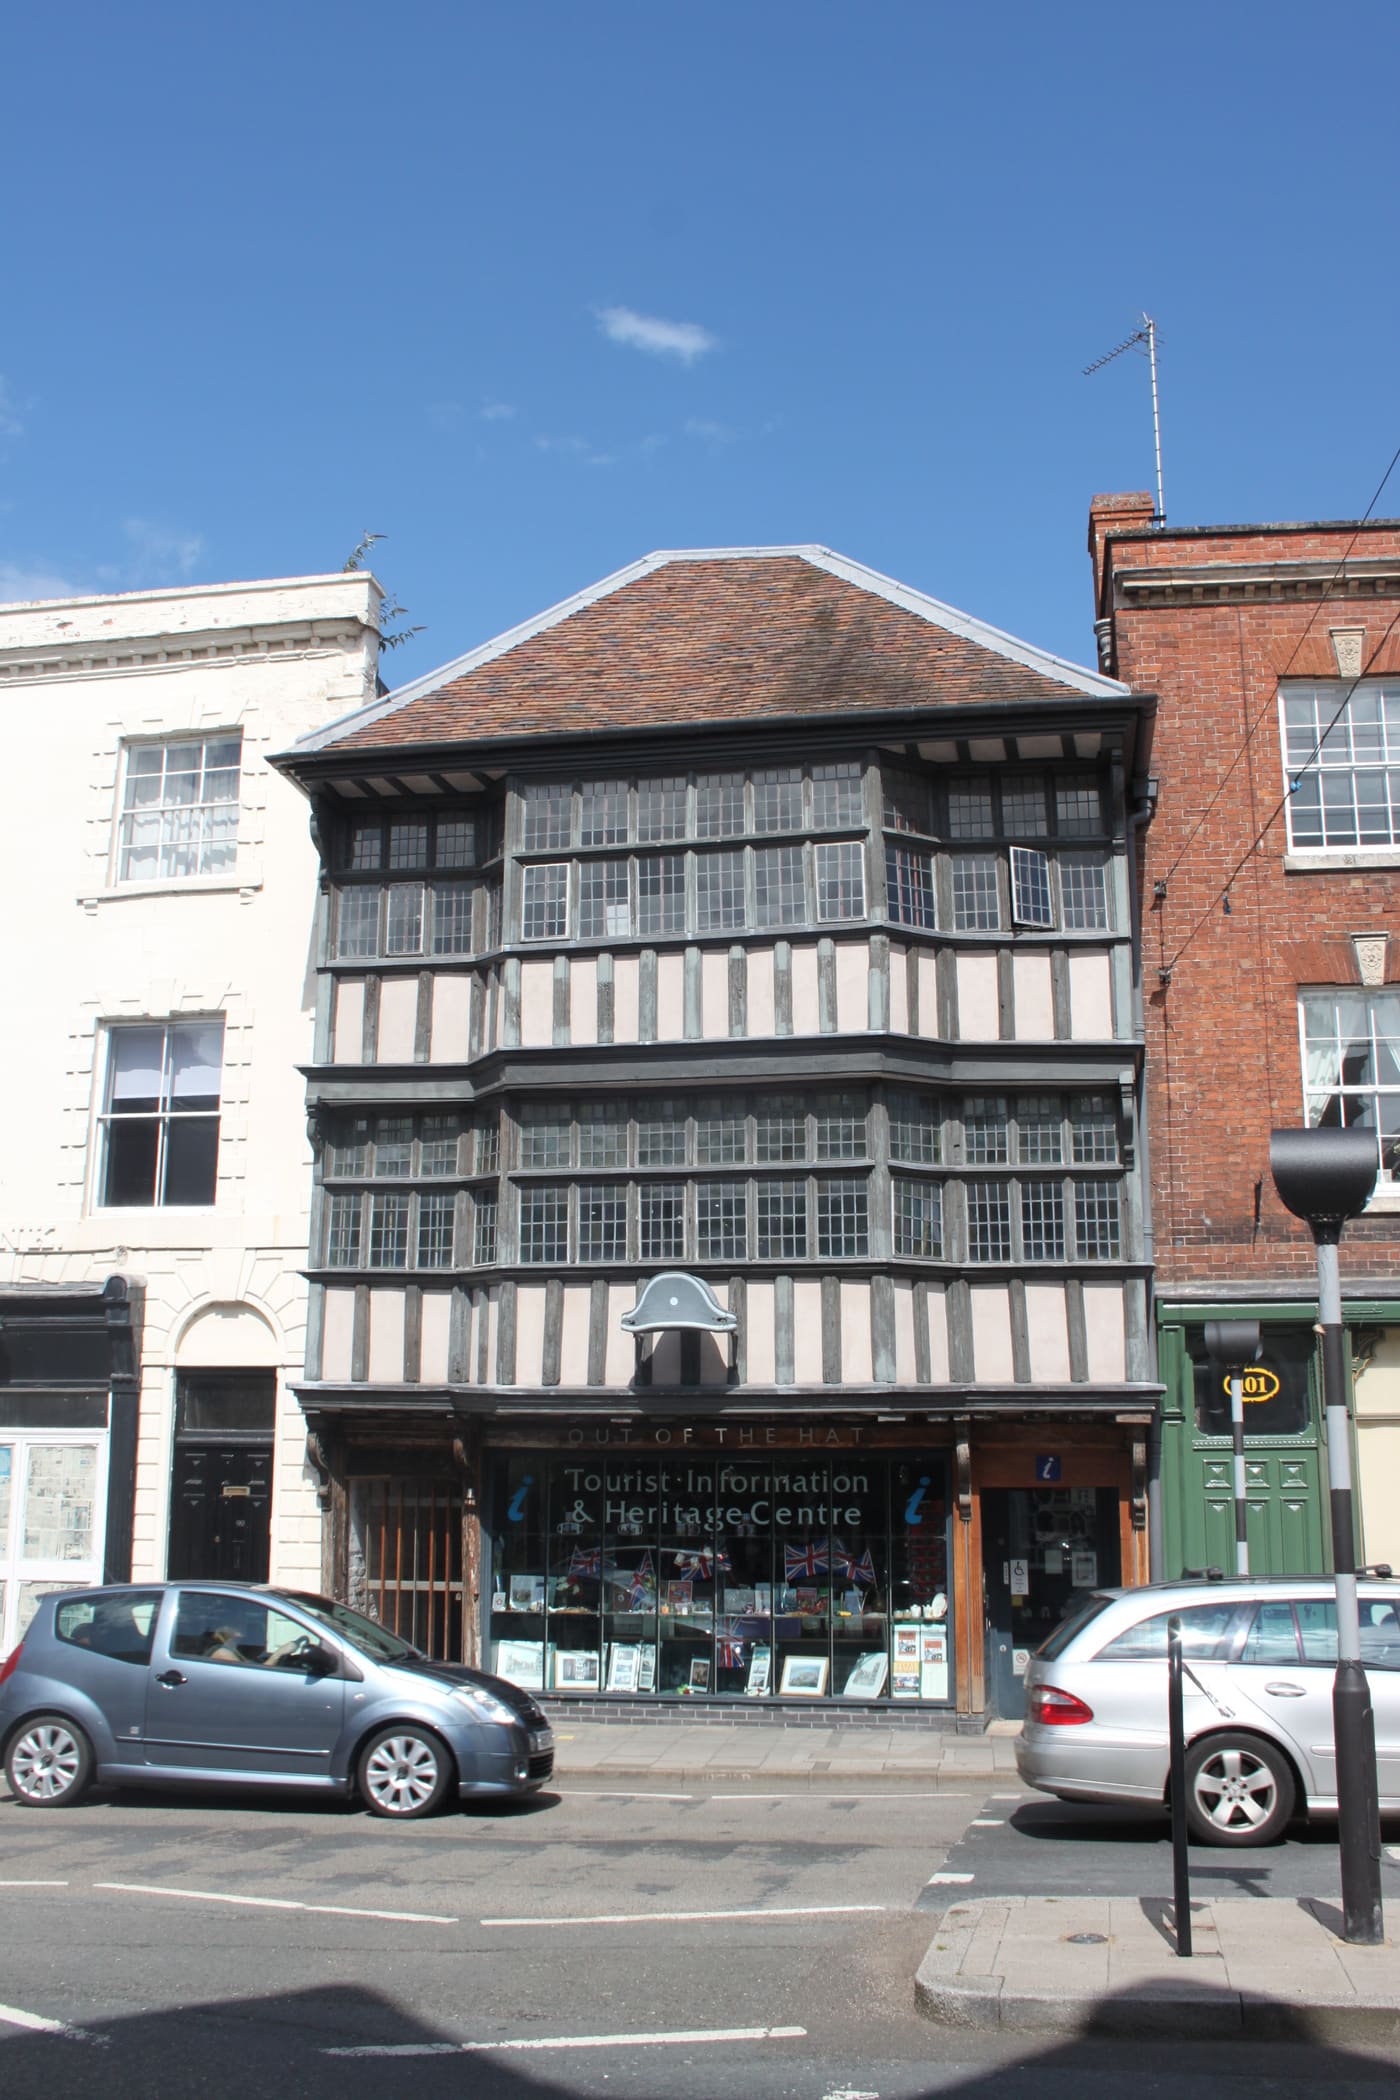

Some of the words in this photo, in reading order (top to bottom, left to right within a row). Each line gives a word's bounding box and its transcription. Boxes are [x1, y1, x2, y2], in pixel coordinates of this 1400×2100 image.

[568, 1428, 633, 1444] OUT
[655, 1428, 693, 1444] OF
[714, 1427, 777, 1444] THE
[800, 1427, 864, 1443] HAT
[566, 1468, 670, 1492] Tourist
[687, 1465, 868, 1493] Information
[572, 1500, 595, 1523] &
[605, 1501, 743, 1532] Heritage
[750, 1501, 862, 1525] Centre
